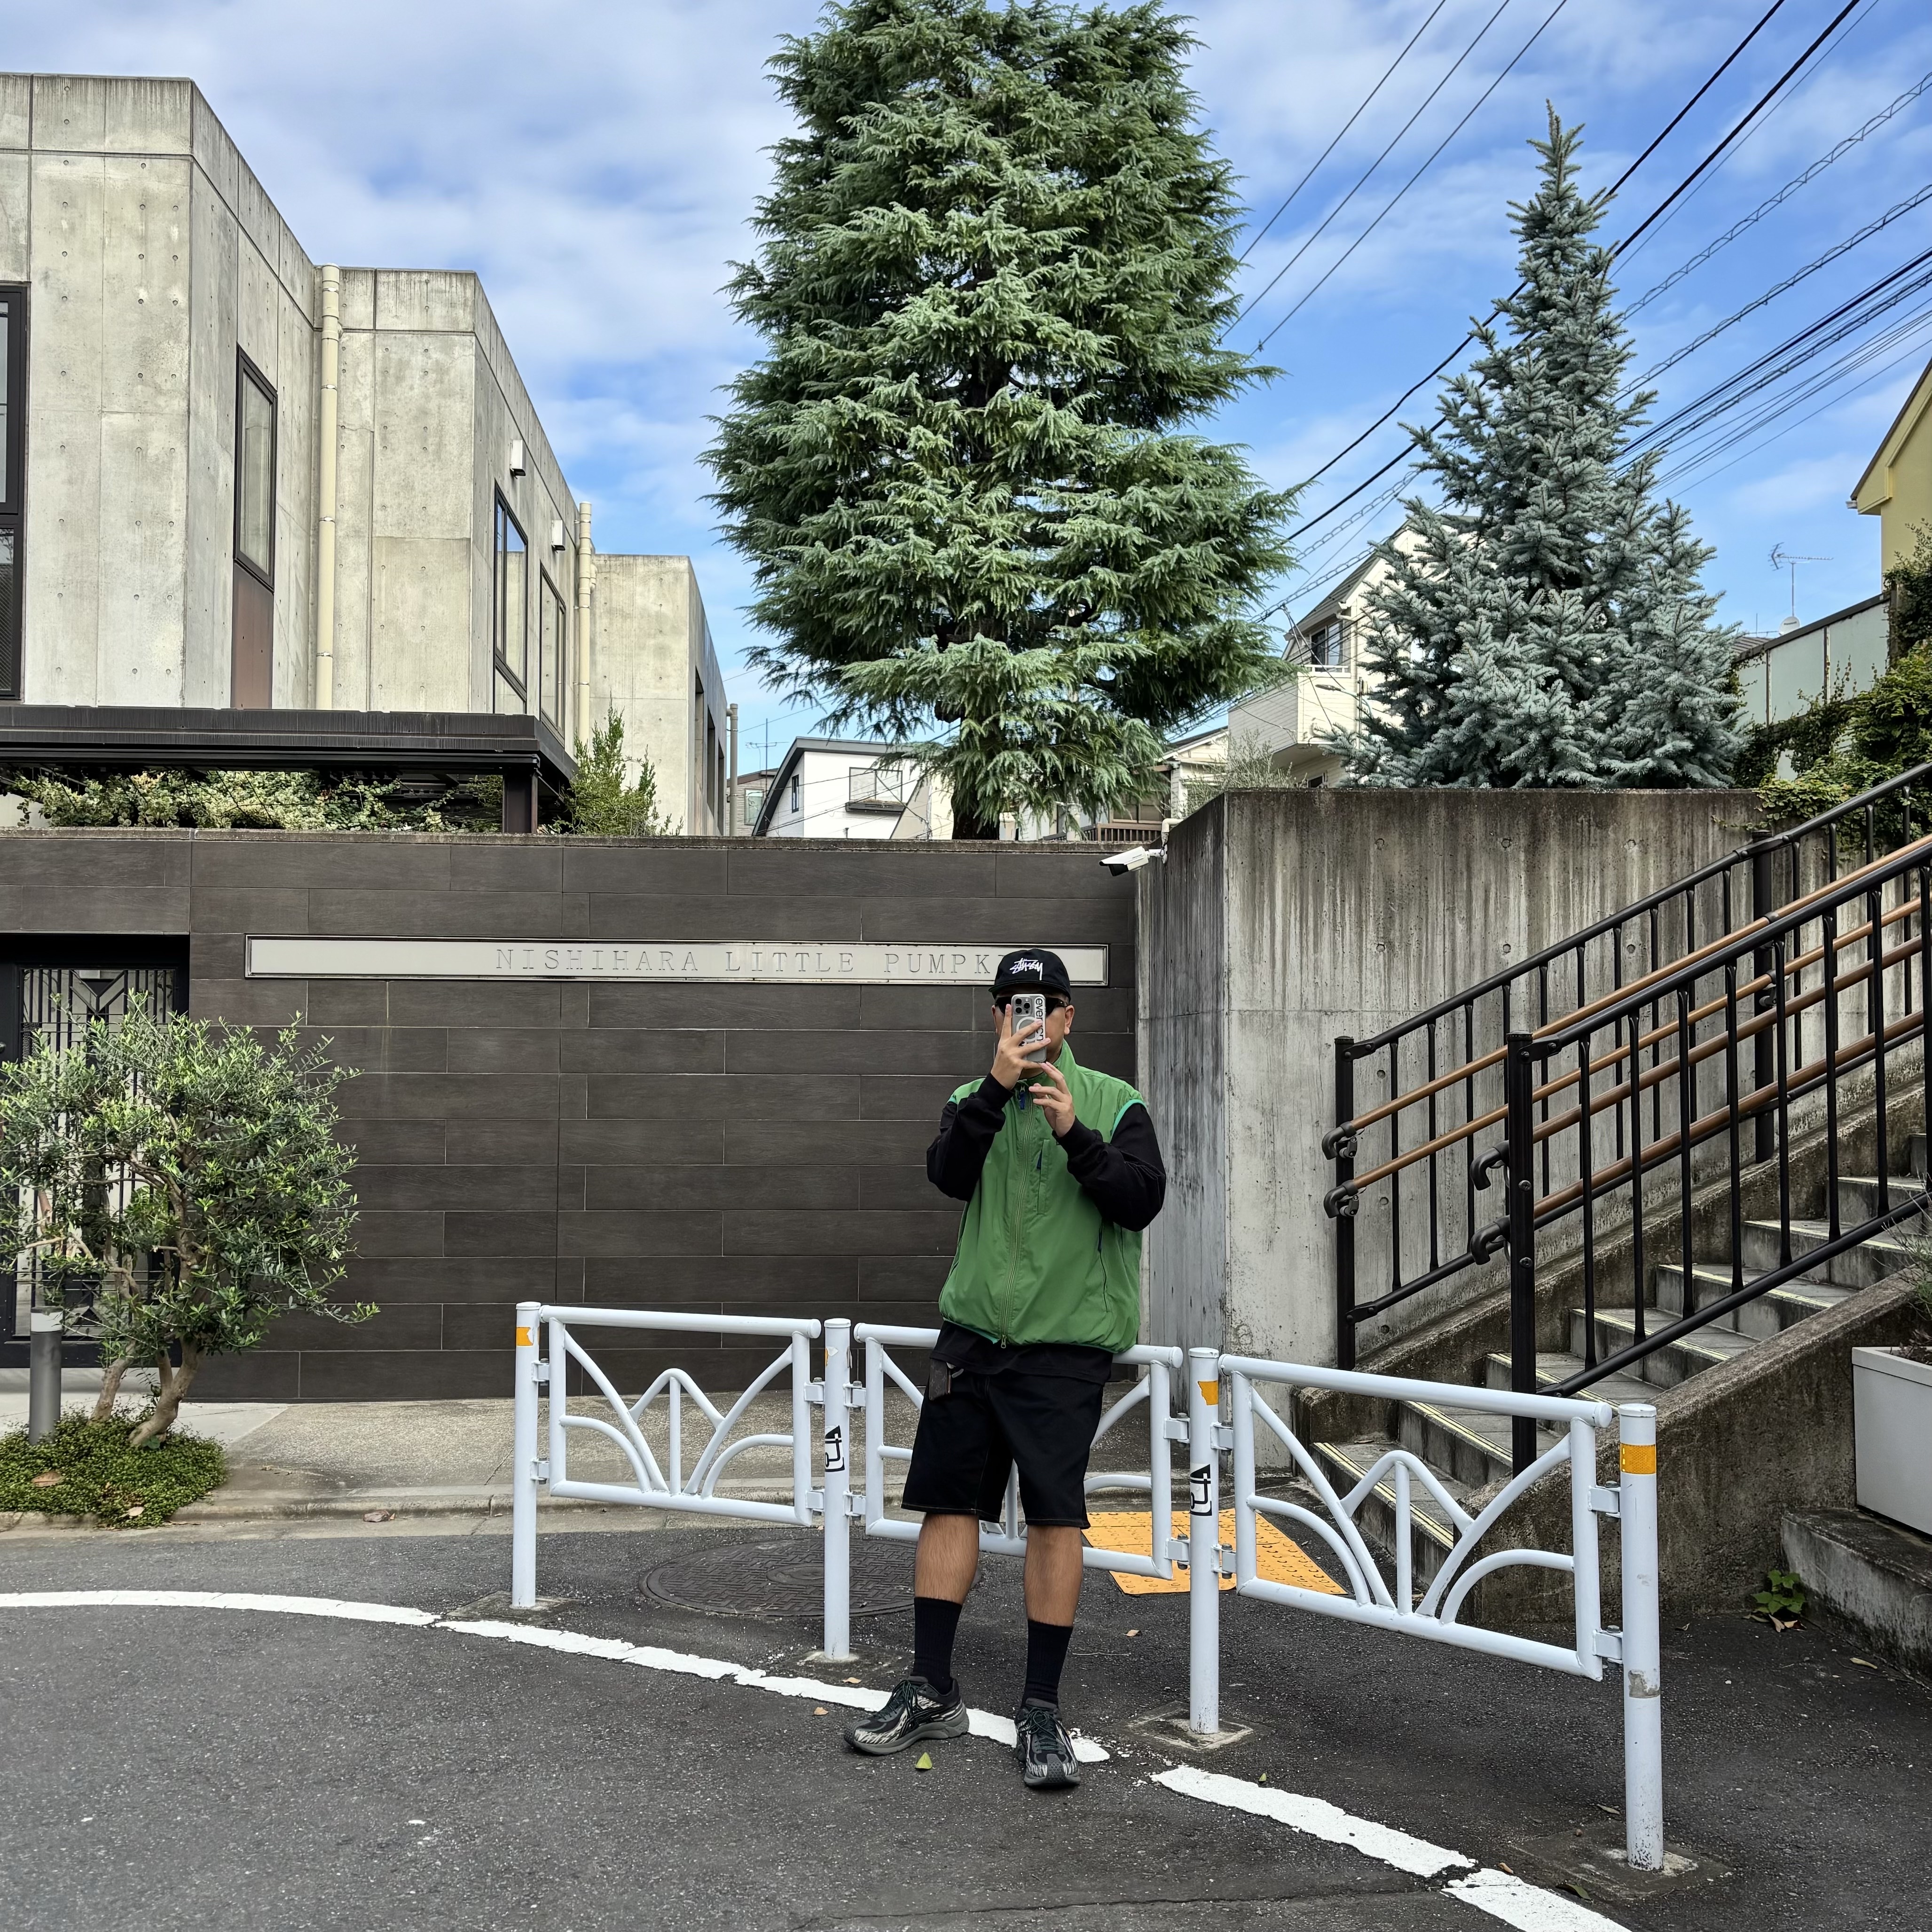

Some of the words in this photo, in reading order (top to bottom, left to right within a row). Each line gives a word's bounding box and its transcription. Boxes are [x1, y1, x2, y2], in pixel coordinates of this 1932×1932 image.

[496, 949, 698, 971] NISHIHARA
[725, 951, 854, 972] LITTLE
[883, 953, 1005, 974] PUMPK
